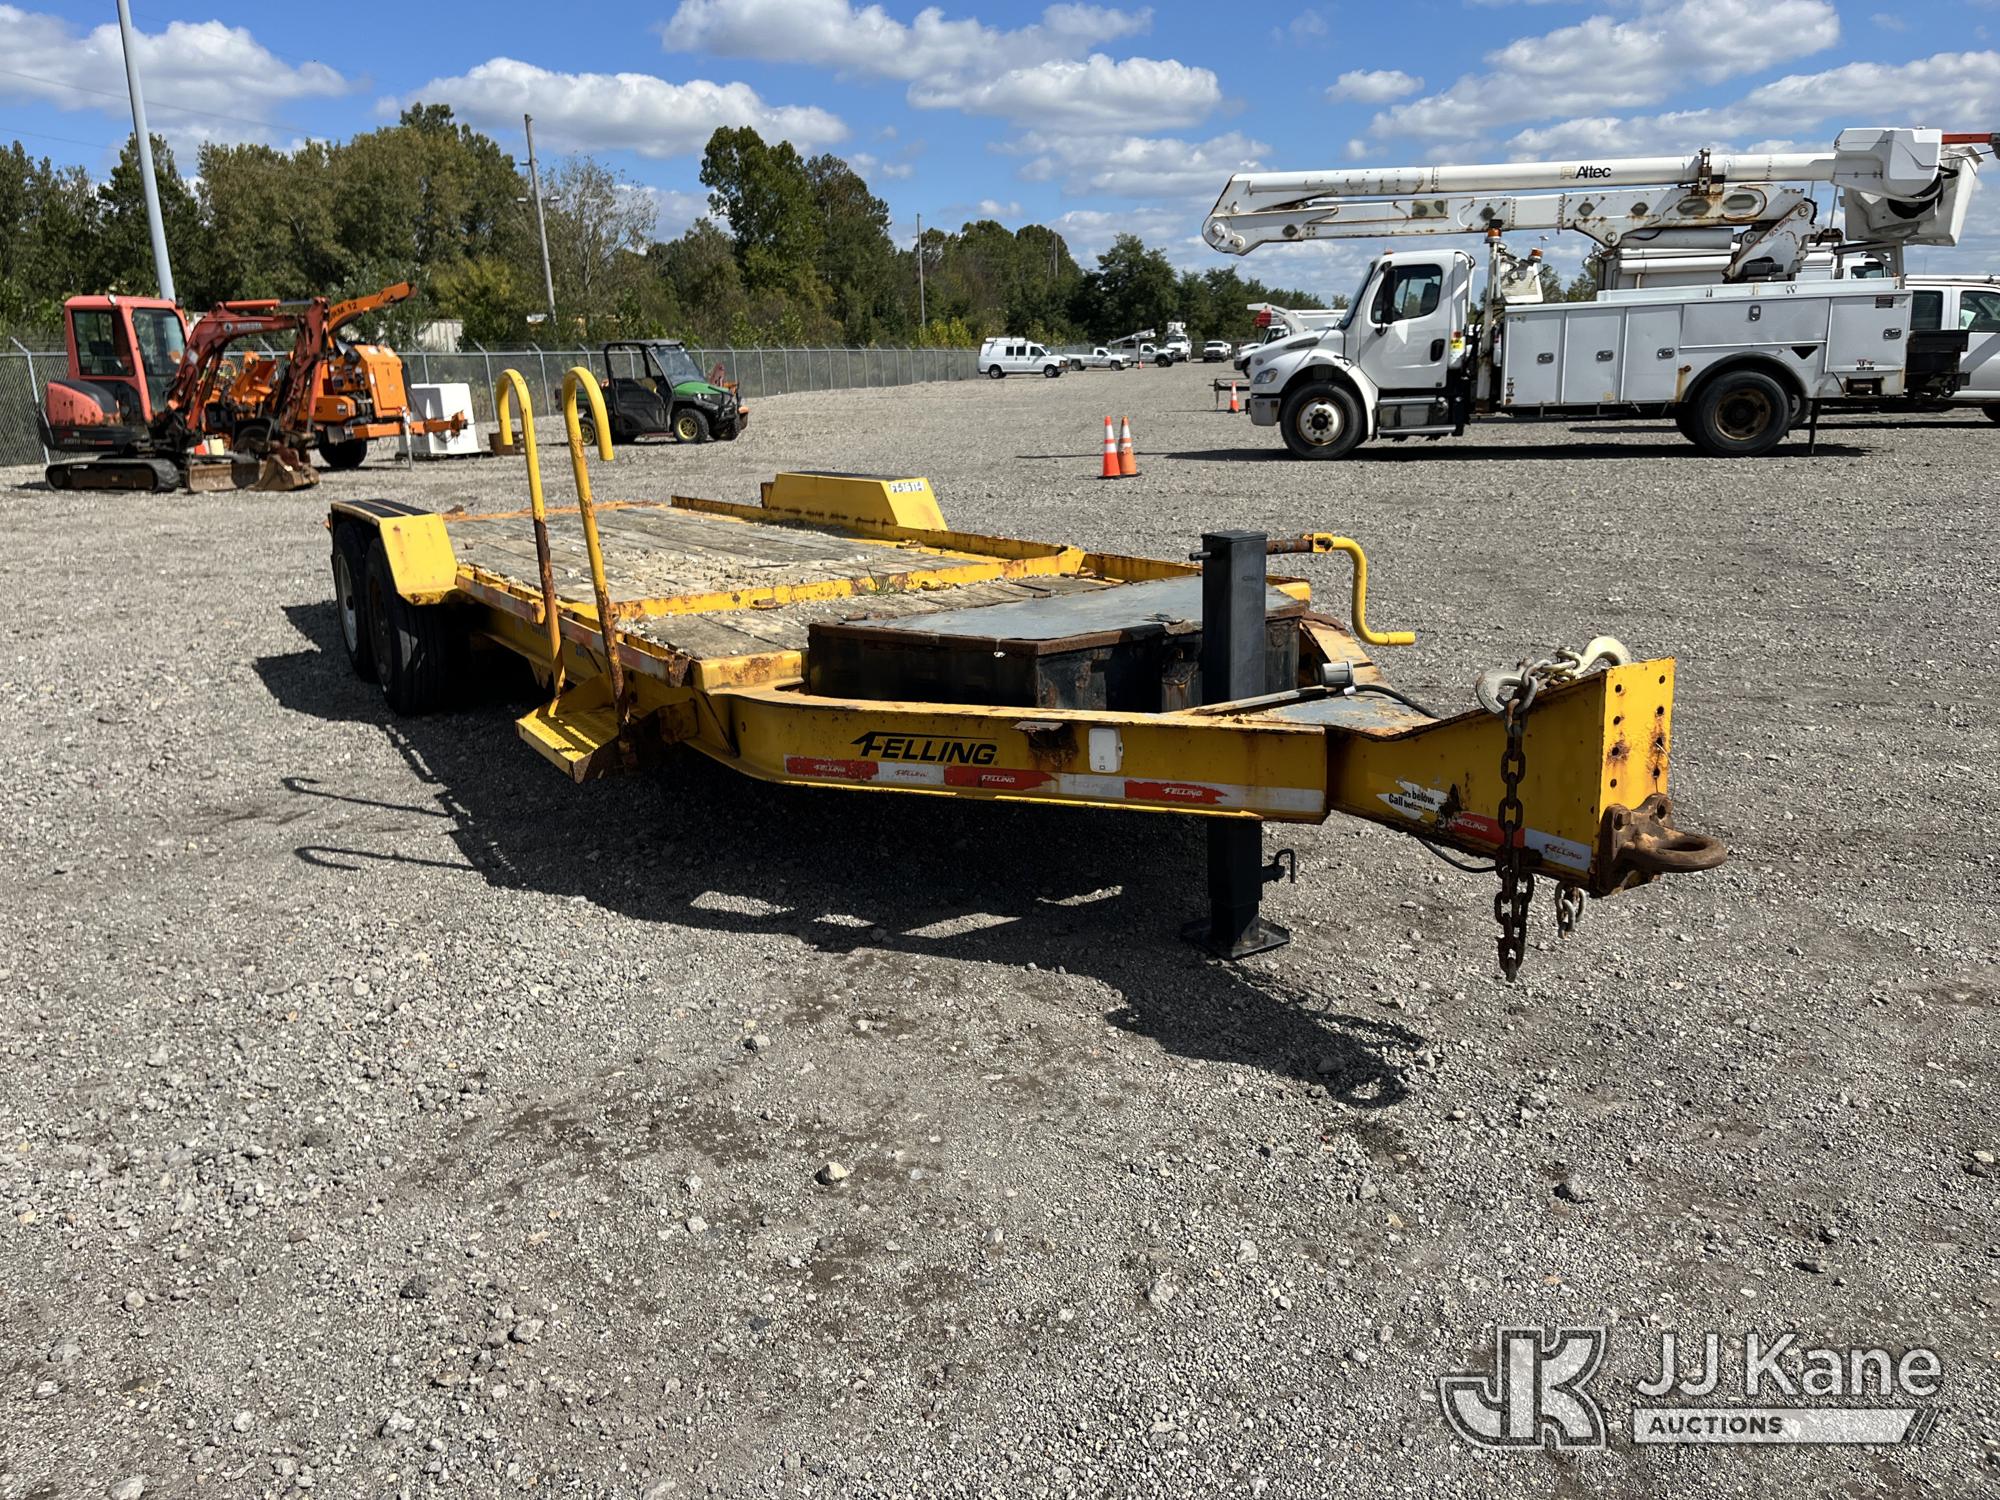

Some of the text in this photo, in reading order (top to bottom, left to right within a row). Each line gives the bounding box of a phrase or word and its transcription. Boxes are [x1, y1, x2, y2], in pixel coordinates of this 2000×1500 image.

[1576, 165, 1612, 179] Altec
[850, 731, 998, 765] FELLING
[981, 774, 1016, 784] FELLING
[1162, 787, 1203, 798] FELLING
[1388, 793, 1403, 806] Call
